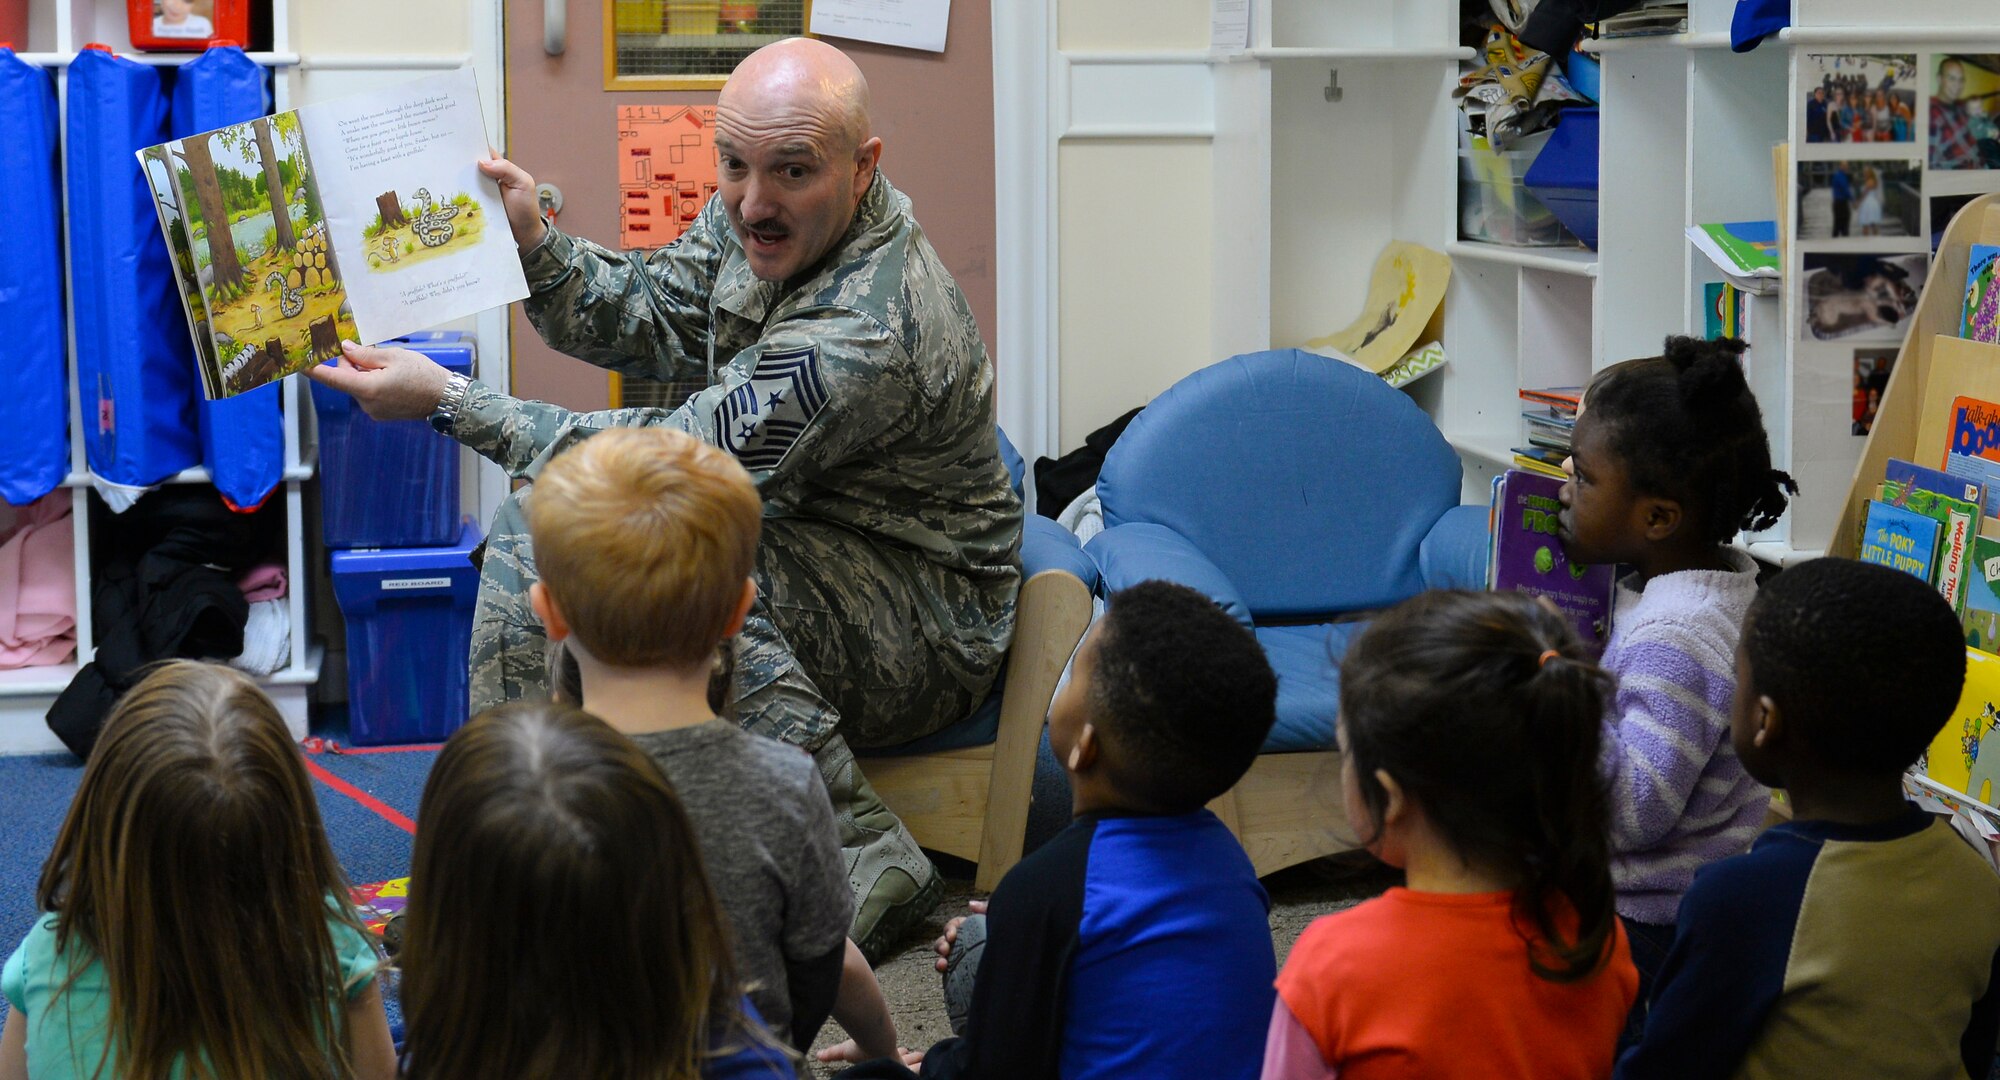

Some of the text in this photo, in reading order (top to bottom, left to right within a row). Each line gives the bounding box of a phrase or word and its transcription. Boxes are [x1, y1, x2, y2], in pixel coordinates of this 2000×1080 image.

[1965, 404, 2000, 426] talk-ab
[1523, 509, 1559, 536] FRO
[1878, 528, 1915, 554] The POKY
[1863, 543, 1925, 577] LITTLE PUPPY
[1946, 520, 1964, 603] Walking Thro
